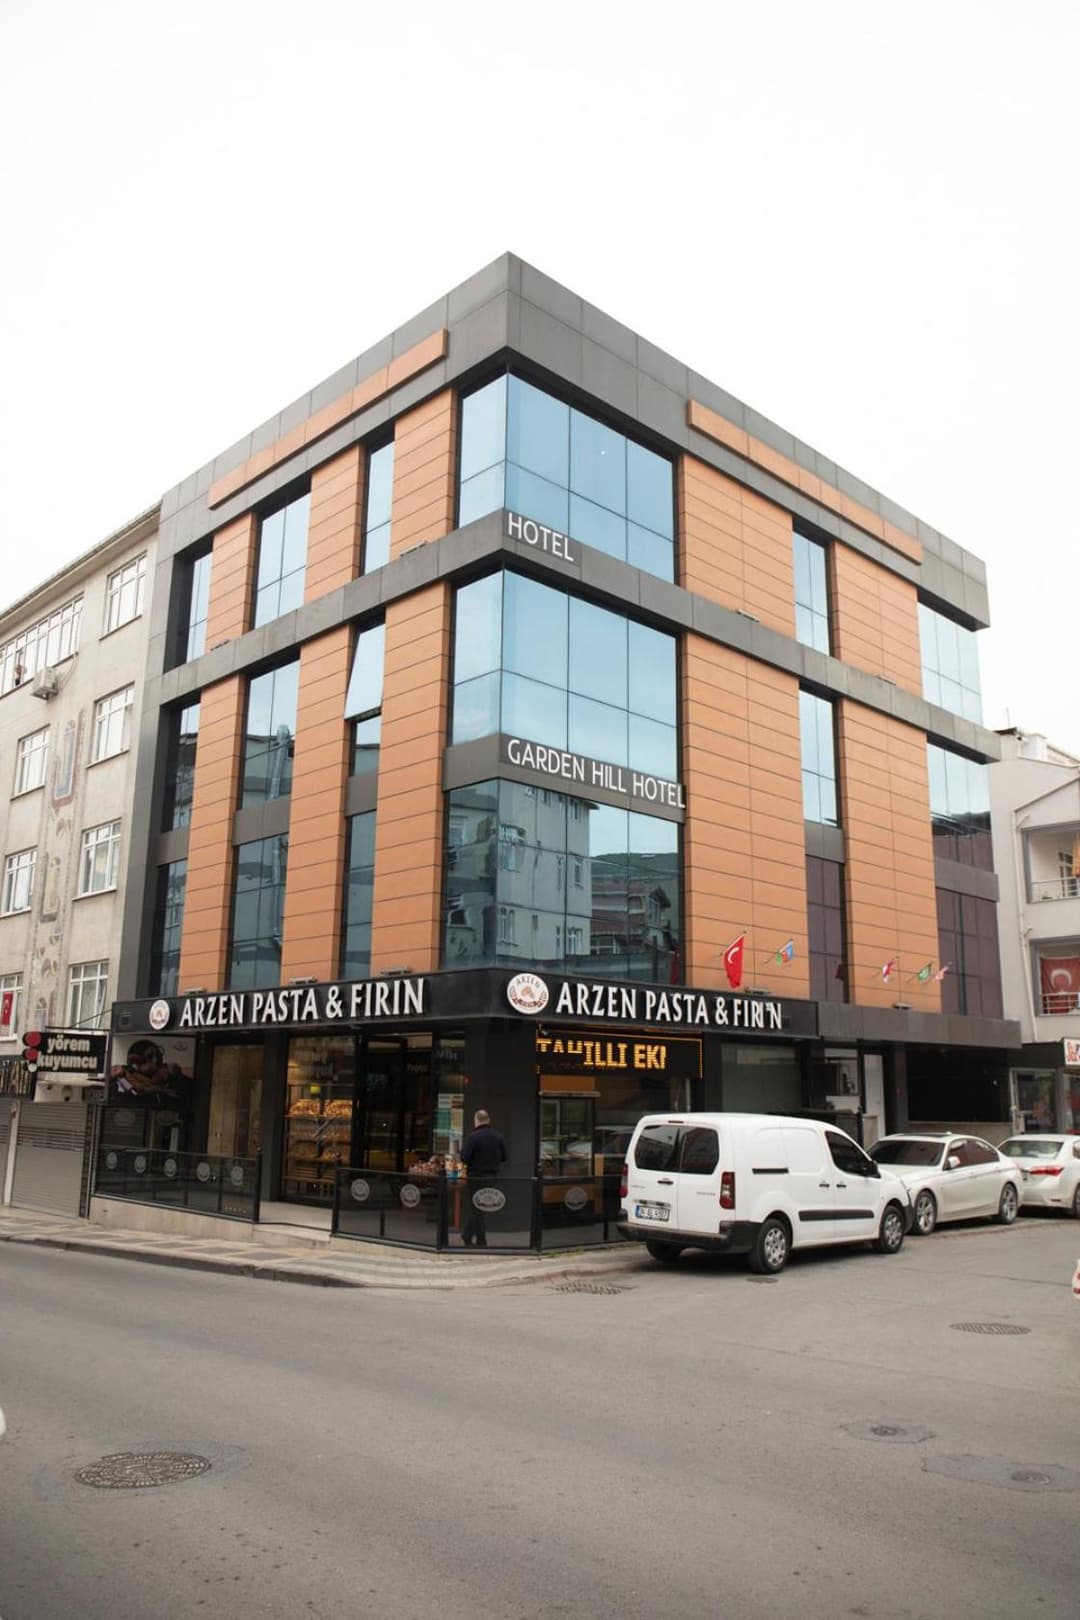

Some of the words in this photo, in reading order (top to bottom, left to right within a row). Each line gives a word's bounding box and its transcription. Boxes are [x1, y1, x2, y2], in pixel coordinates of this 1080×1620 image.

[508, 512, 574, 561] HOTEL
[508, 739, 585, 782] GARDEN
[592, 761, 627, 793] HILL
[633, 772, 685, 808] HOTEL
[179, 994, 245, 1027] ARZEN
[252, 988, 319, 1023] PASTA
[325, 985, 343, 1018] &
[350, 978, 425, 1017] FIRIN
[556, 982, 637, 1019] ARZEN
[645, 990, 709, 1025] PASTA
[715, 996, 729, 1025] &
[37, 1051, 98, 1070] kuyumcu
[47, 1034, 91, 1053] yörem
